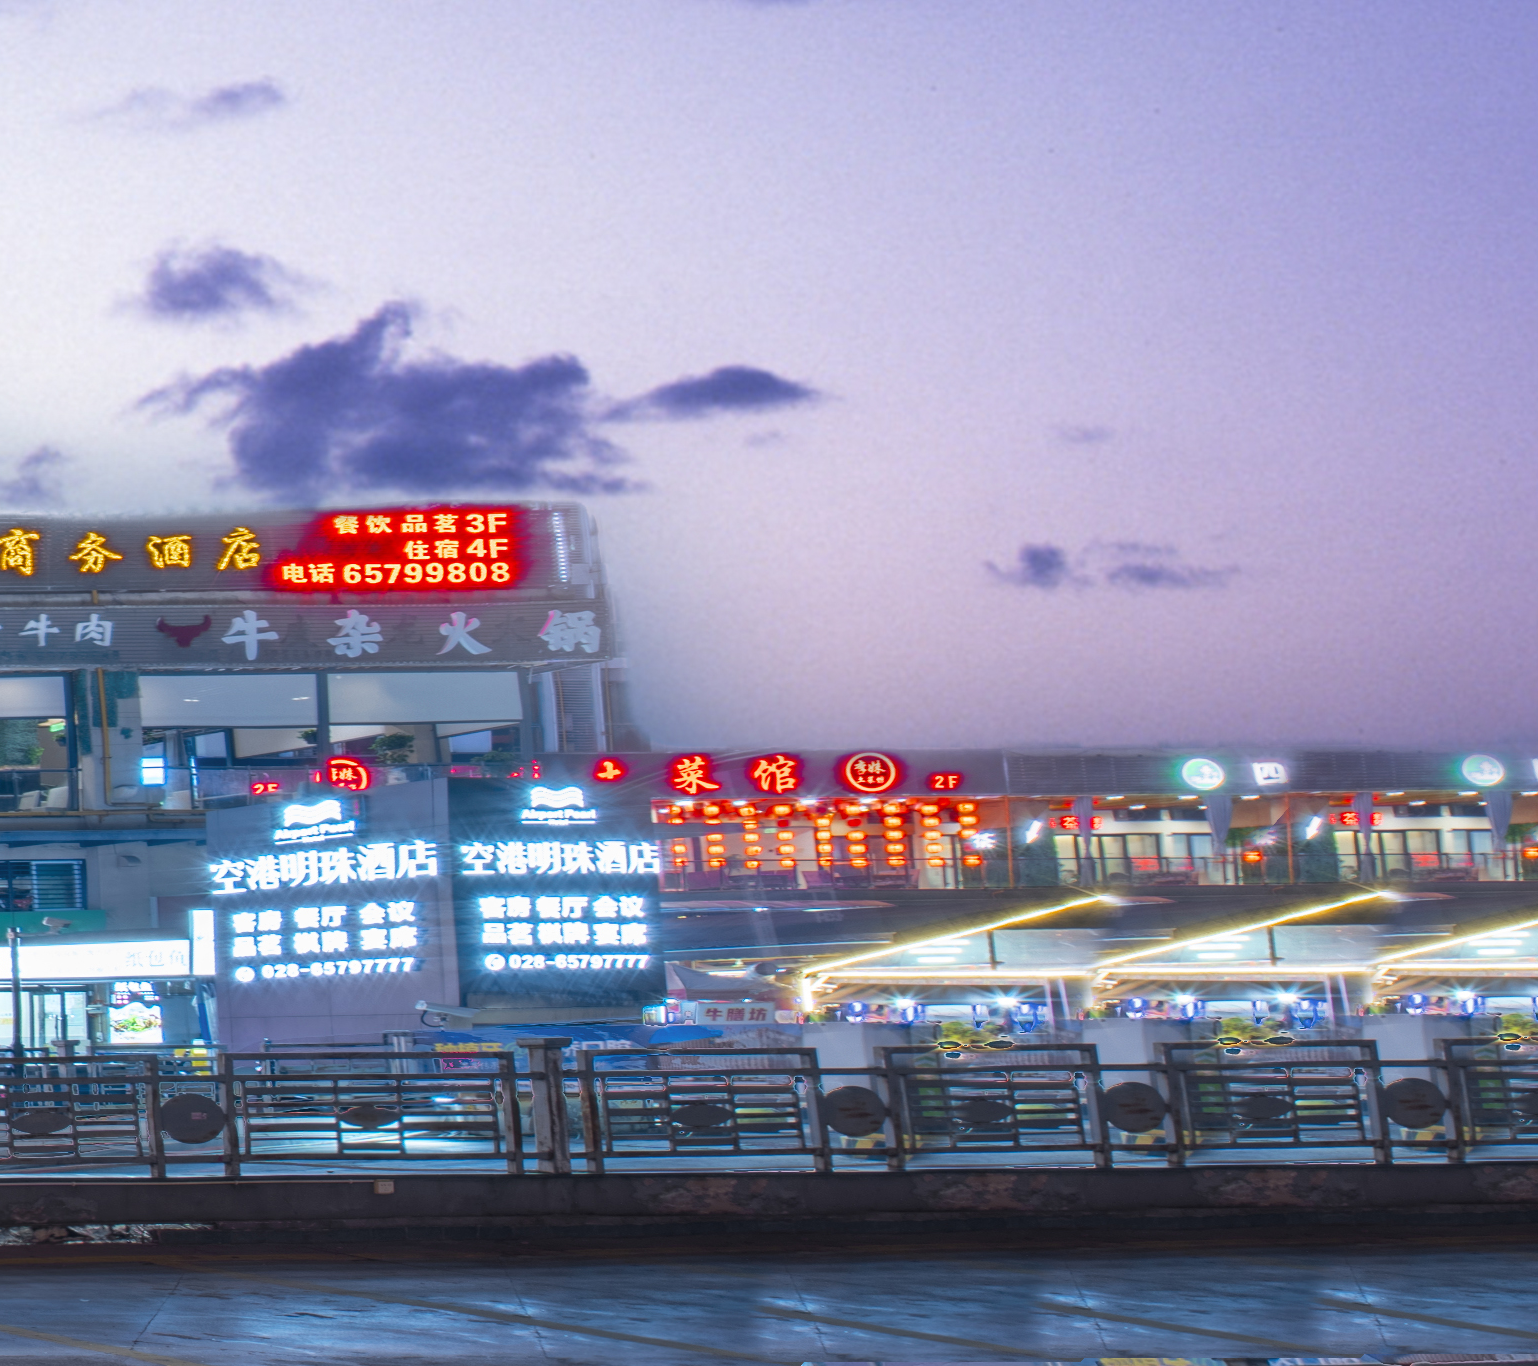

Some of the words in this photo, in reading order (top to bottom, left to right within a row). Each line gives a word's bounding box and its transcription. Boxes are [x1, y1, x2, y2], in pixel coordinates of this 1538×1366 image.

[334, 514, 392, 535] 餐饮
[401, 514, 459, 534] 品茗
[465, 513, 507, 533] 3F
[404, 539, 460, 560] 住宿
[466, 538, 509, 559] 4F
[282, 562, 336, 584] 电话
[343, 562, 510, 584] 65799808
[221, 609, 602, 661] 牛杂火锅
[934, 775, 959, 788] 2F
[210, 840, 438, 895] 空港明珠酒店
[461, 841, 661, 875] 空港明珠酒店
[232, 910, 282, 933] 客房
[293, 905, 347, 929] 餐厅
[359, 900, 417, 925] 会议
[479, 896, 531, 919] 客房
[536, 896, 588, 919] 餐厅
[592, 896, 645, 919] 会议
[261, 956, 415, 978] 028-65797777
[509, 954, 649, 969] 028-65797777
[705, 1007, 769, 1022] 牛膳坊
